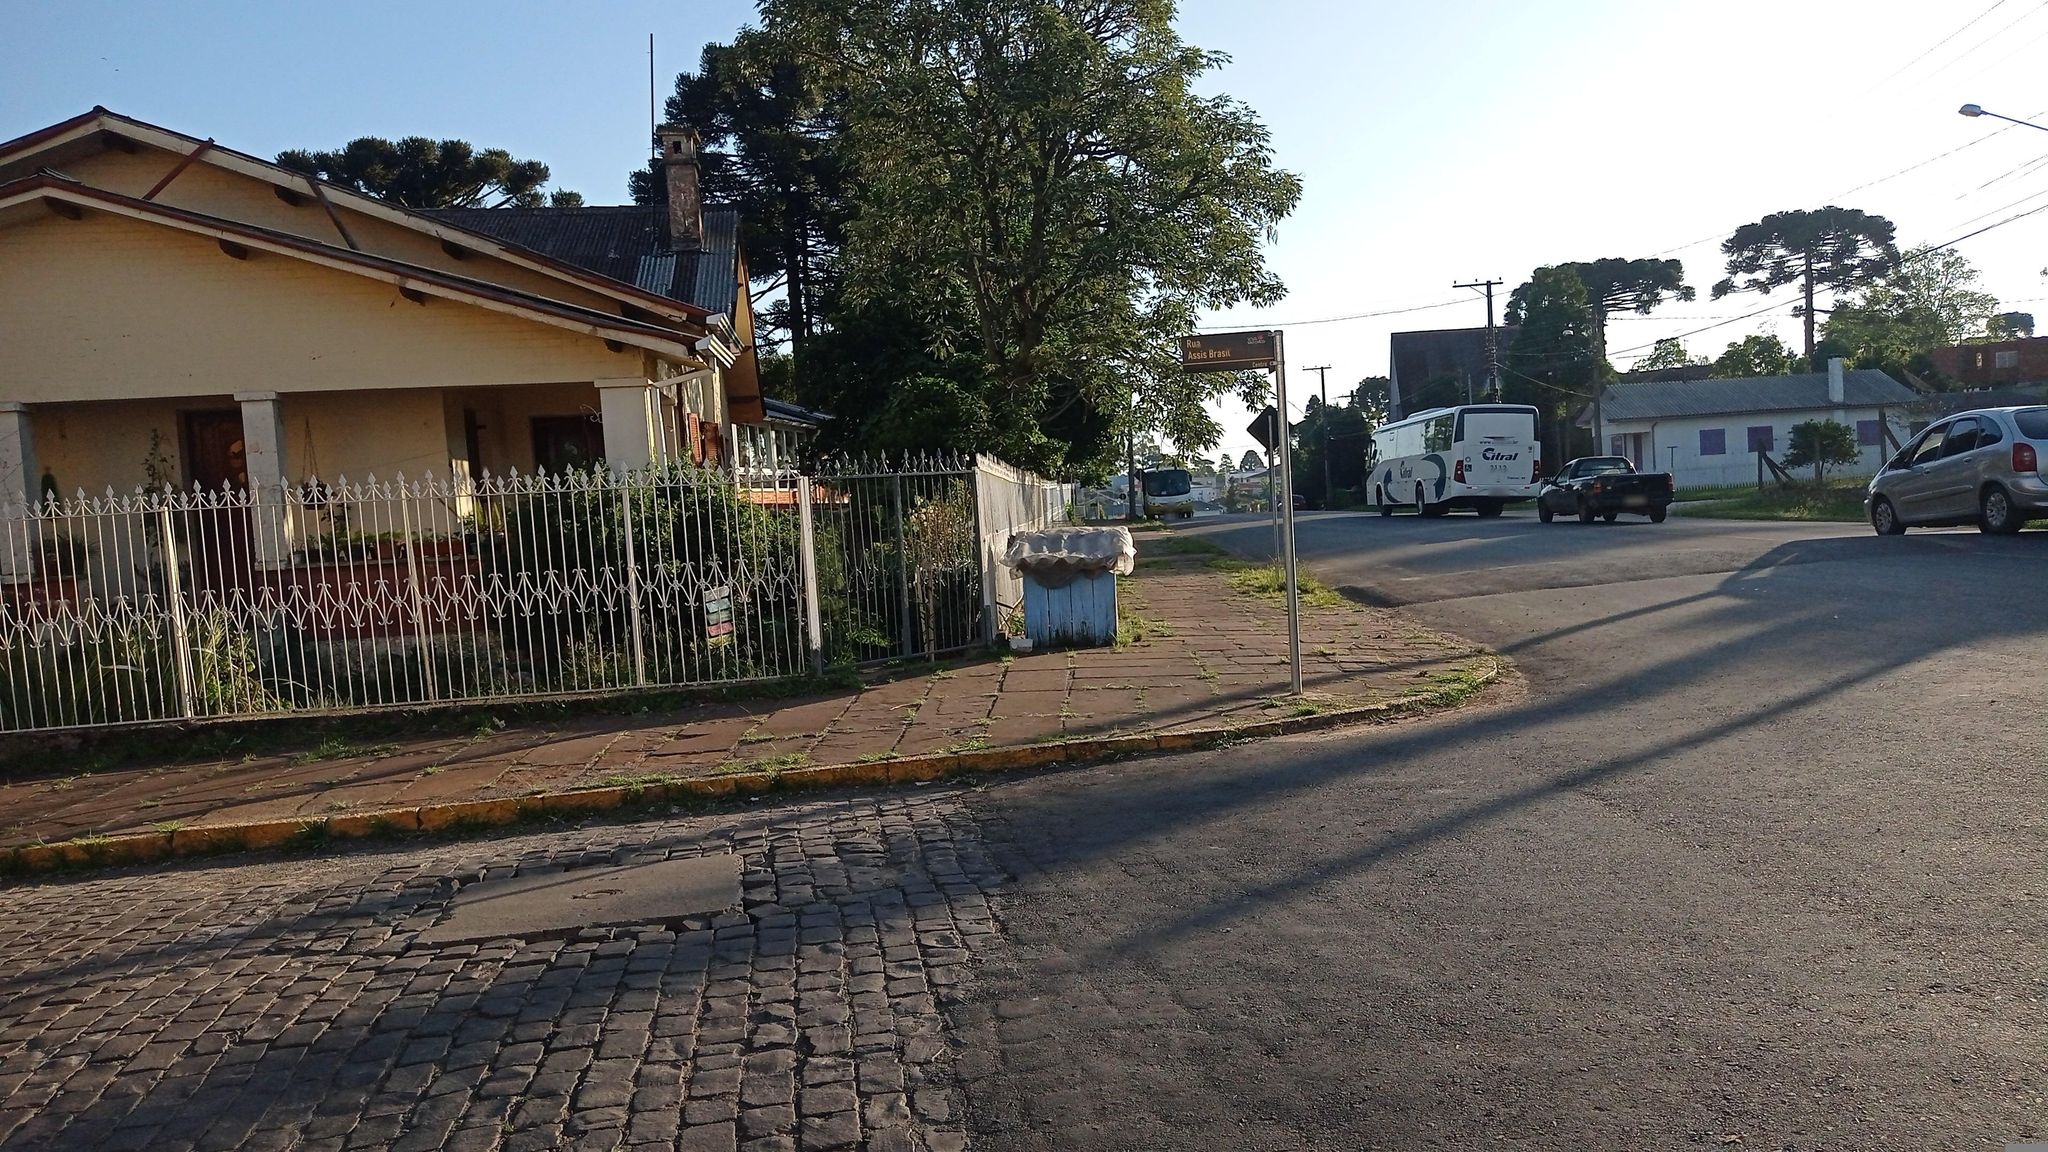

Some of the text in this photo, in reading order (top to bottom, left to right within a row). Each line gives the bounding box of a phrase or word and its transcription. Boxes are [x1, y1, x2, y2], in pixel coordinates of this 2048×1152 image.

[1186, 339, 1201, 349] Rua
[1187, 349, 1231, 360] Assis Brasil
[1482, 447, 1519, 461] Citral
